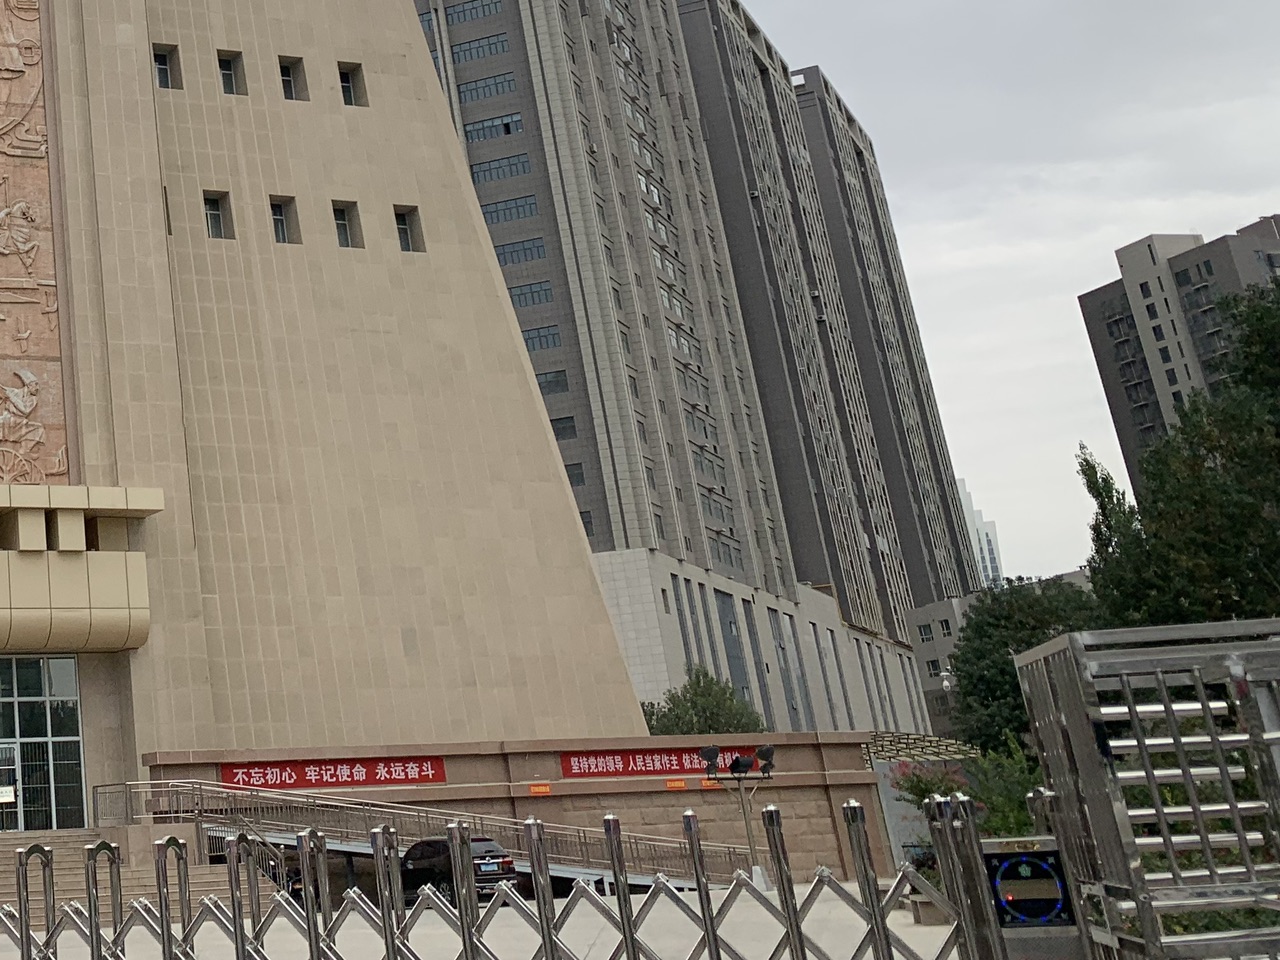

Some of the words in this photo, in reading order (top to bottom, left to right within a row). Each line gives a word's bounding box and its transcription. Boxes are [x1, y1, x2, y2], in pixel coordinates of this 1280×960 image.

[233, 766, 297, 785] 不忘初心
[305, 763, 367, 783] 牢记使命
[375, 761, 435, 780] 永远奋斗
[570, 755, 624, 773] 坚持党的领导
[628, 753, 680, 771] 人民当家作主
